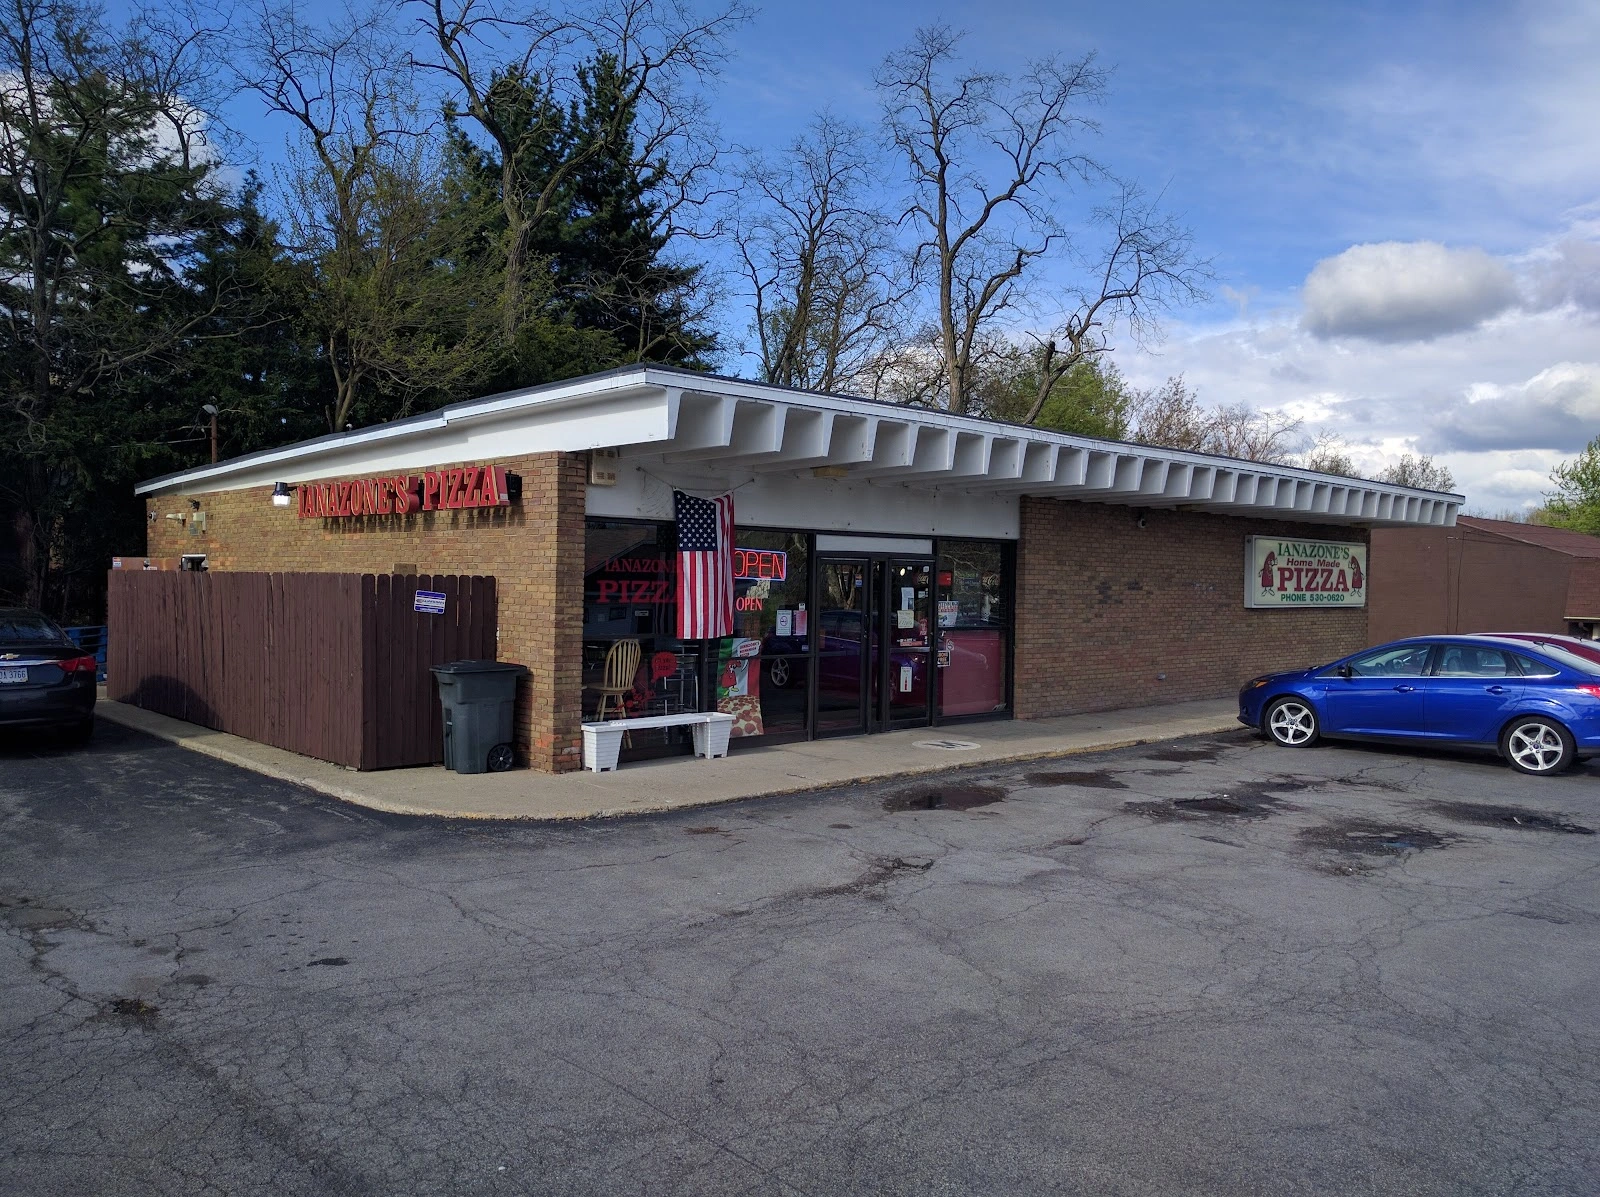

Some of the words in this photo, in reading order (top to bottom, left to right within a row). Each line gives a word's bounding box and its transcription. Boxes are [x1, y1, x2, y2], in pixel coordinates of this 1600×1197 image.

[297, 475, 411, 518] IANAZONE'S
[422, 465, 502, 510] PIZZA
[1277, 543, 1350, 560] IANAZONE'S
[734, 551, 785, 579] OPEN
[1286, 558, 1313, 567] Home
[1316, 559, 1341, 568] Made
[1277, 567, 1350, 592] PIZZA
[736, 597, 763, 611] OPEN
[1280, 594, 1307, 602] PHONE
[1309, 594, 1345, 602] 530-0620
[9, 670, 26, 678] 3766
